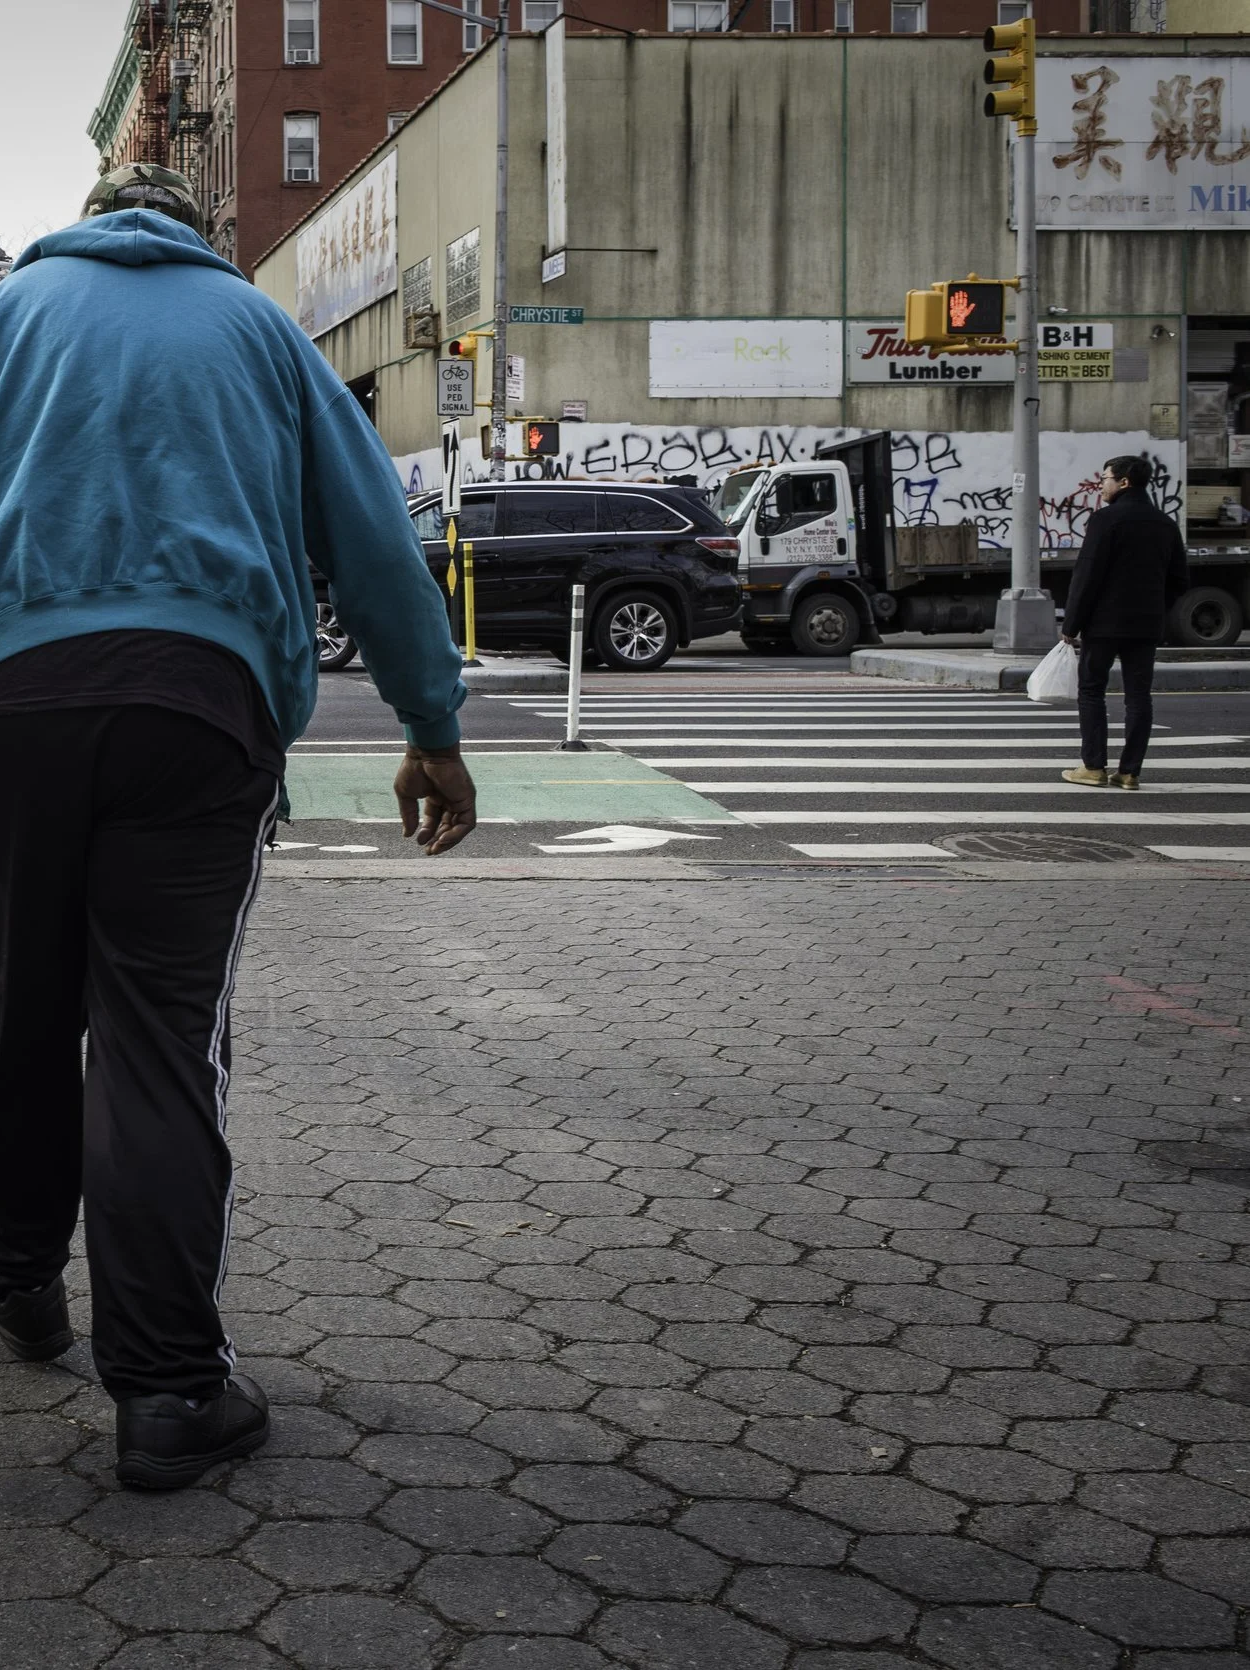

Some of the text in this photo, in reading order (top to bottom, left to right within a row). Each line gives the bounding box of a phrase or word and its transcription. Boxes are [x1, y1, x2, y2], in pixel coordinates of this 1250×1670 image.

[1036, 194, 1061, 212] 79
[510, 307, 582, 323] CHRYSTIE ST
[732, 336, 792, 362] Rock
[1037, 351, 1111, 361] ASHING CEMENT
[888, 360, 983, 380] Lumber
[1037, 365, 1069, 378] ETTER
[1082, 364, 1111, 378] BEST
[446, 383, 463, 392] USE
[446, 393, 463, 402] PED
[441, 403, 470, 411] SIGNAL
[792, 537, 828, 545] CHRYSTIE
